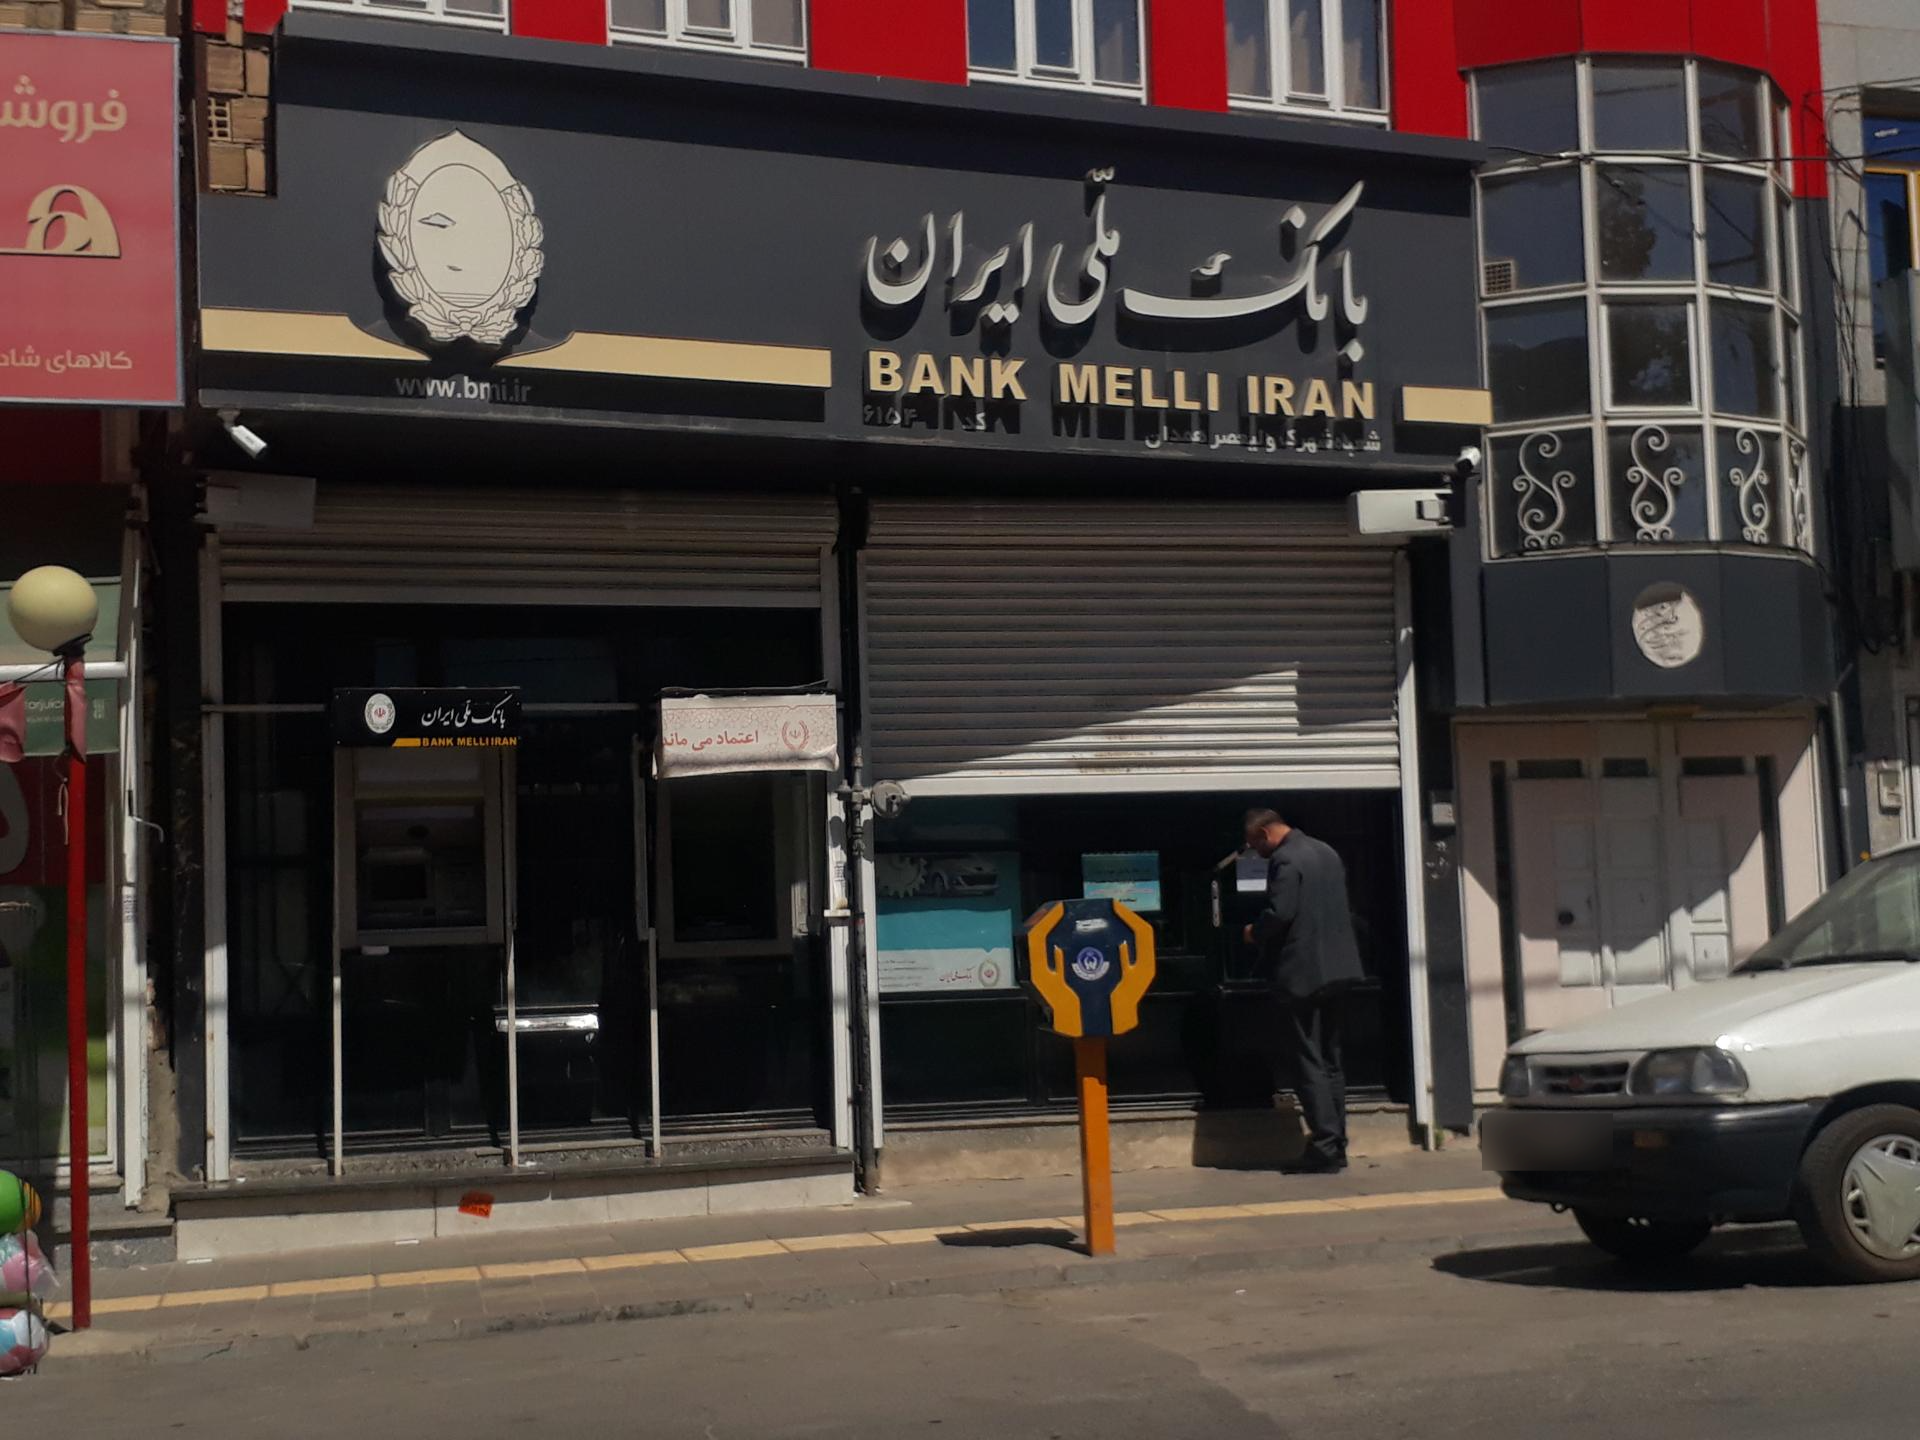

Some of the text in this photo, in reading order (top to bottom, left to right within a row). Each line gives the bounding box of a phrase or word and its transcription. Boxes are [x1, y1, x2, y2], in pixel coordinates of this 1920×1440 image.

[867, 210, 1034, 324] ایران
[1117, 180, 1367, 363] بانک
[46, 350, 132, 373] کالاهای
[395, 375, 532, 402] www.bmi.ir
[868, 350, 1375, 420] BANK MELLI IRAN
[421, 706, 454, 727] ایران
[471, 694, 513, 729] بانک
[422, 736, 518, 747] BANK MELLI IRAN
[692, 734, 712, 752] می
[716, 730, 759, 745] اعتماد
